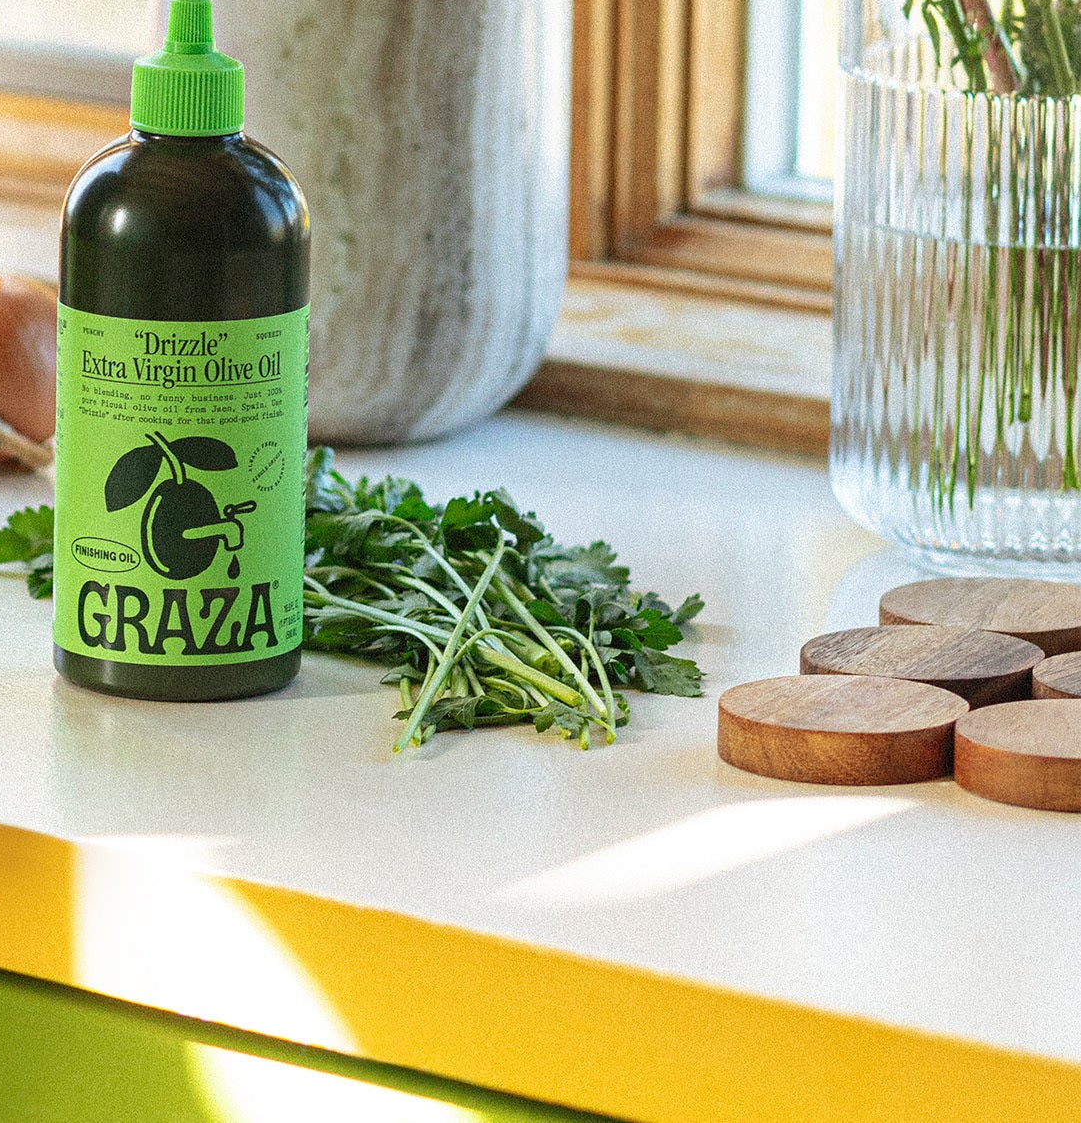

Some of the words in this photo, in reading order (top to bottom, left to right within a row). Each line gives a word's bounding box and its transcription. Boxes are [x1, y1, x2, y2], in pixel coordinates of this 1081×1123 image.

[81, 350, 128, 379] Extra
[132, 357, 196, 389] Virgin
[204, 357, 253, 382] Olive
[258, 351, 281, 378] Oil
[82, 385, 89, 393] No
[94, 387, 132, 400] blending,
[158, 394, 185, 403] funny
[191, 394, 237, 402] business.
[244, 391, 262, 399] Just
[81, 397, 97, 406] pure
[101, 399, 127, 409] Picual
[132, 404, 158, 412] olive
[163, 405, 178, 413] oil
[241, 402, 267, 411] Spain.
[113, 413, 135, 422] after
[139, 416, 173, 425] cooking
[196, 416, 215, 425] that
[75, 546, 117, 562] FINISHING
[119, 552, 136, 565] OIL
